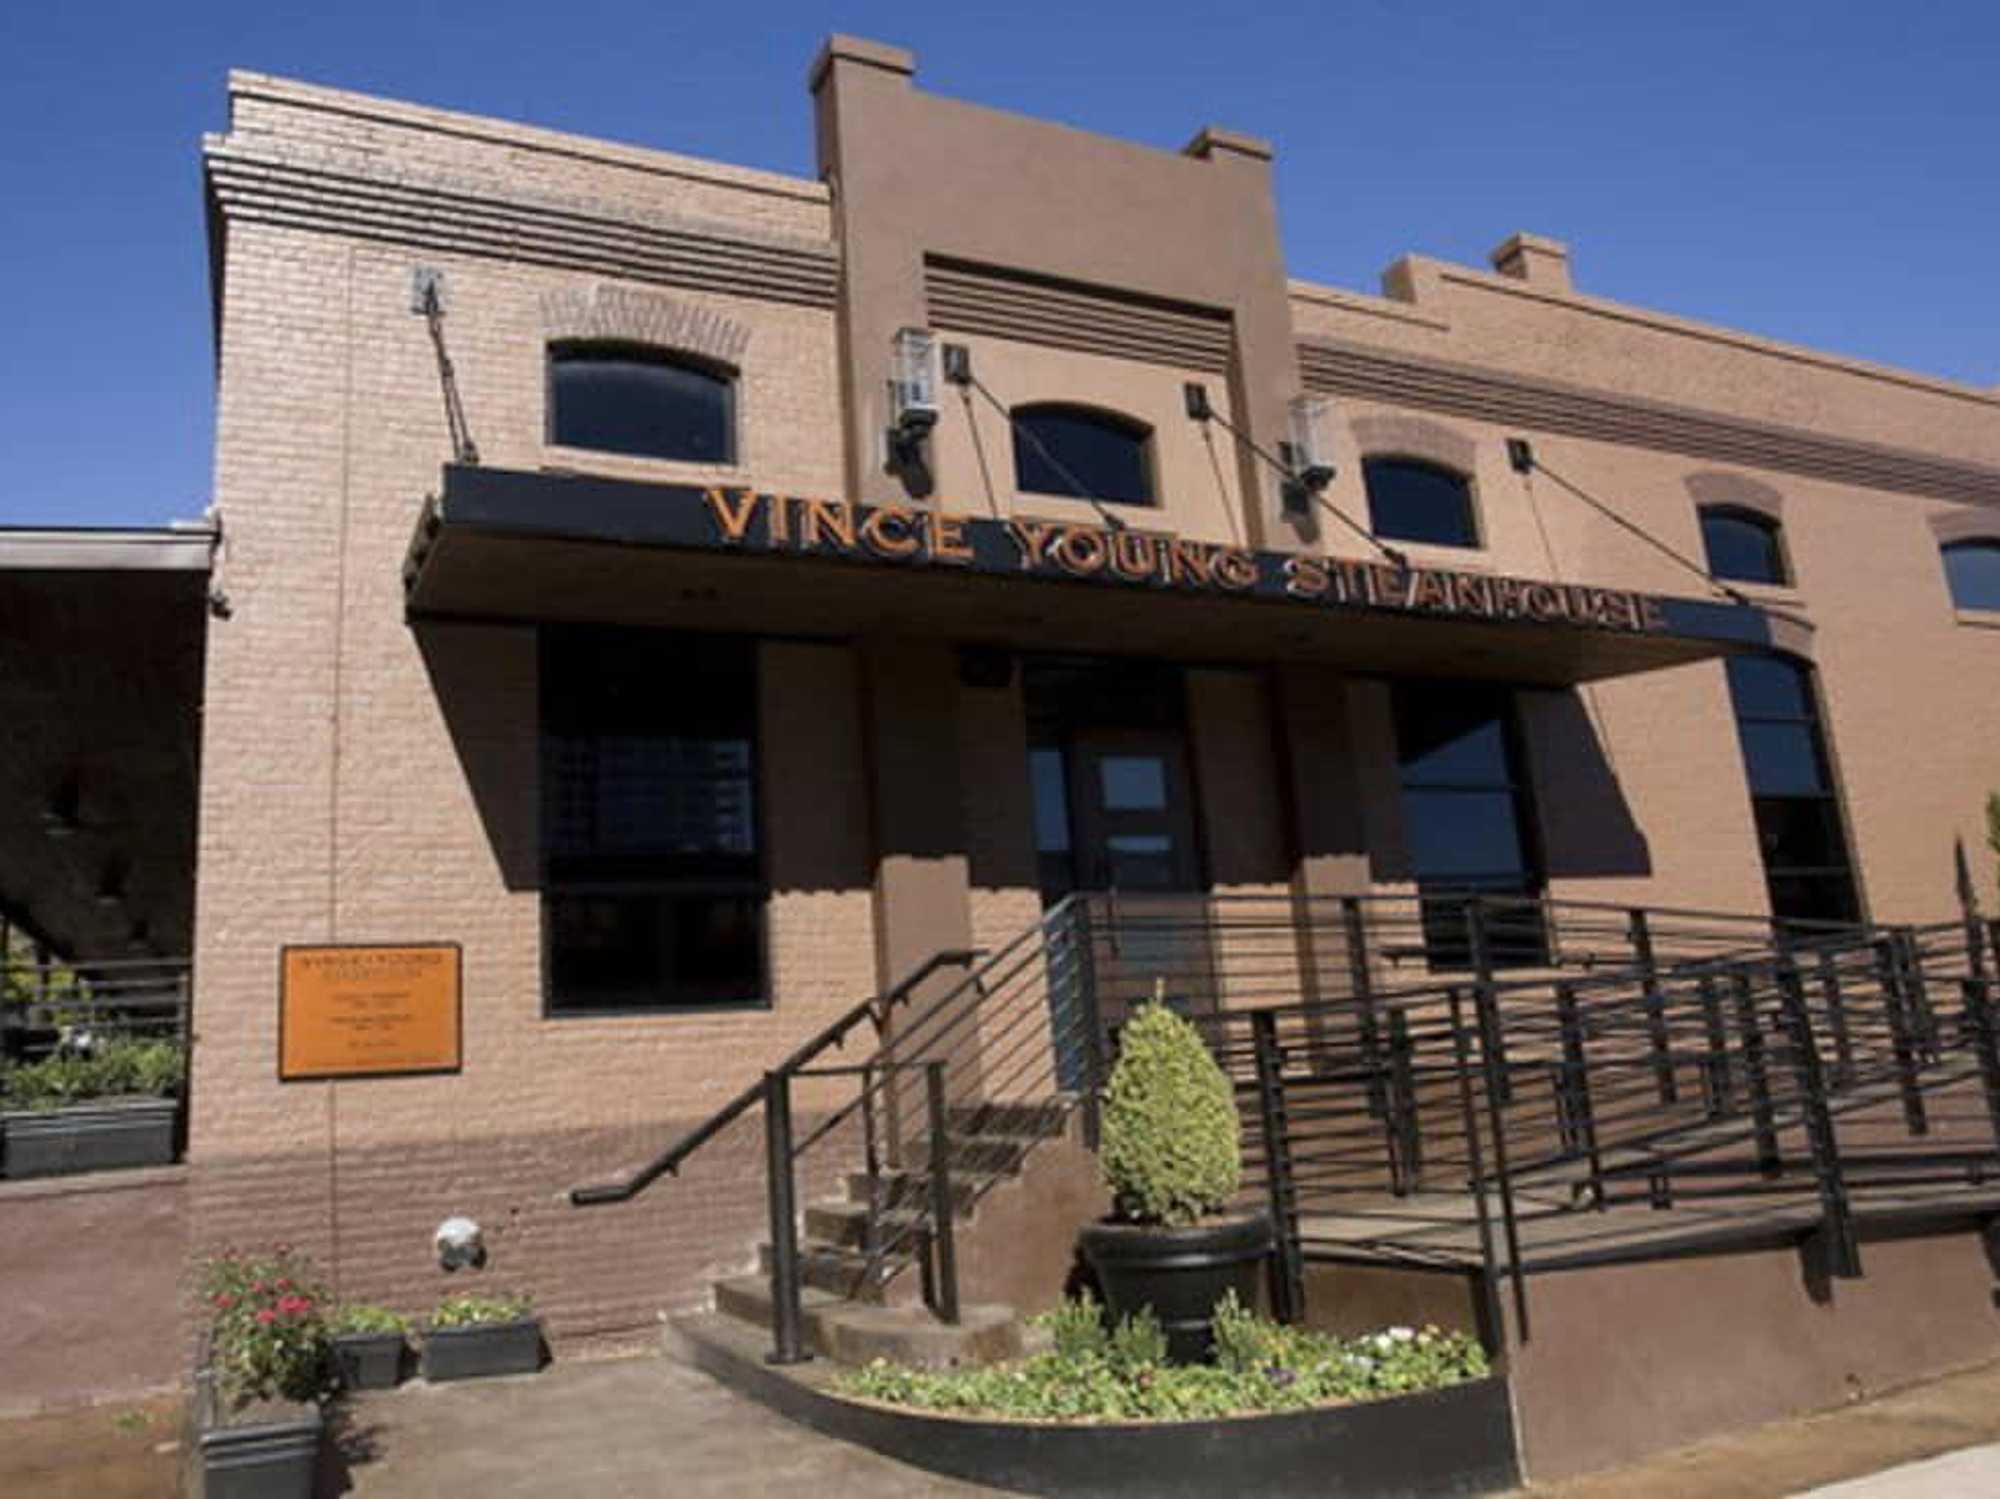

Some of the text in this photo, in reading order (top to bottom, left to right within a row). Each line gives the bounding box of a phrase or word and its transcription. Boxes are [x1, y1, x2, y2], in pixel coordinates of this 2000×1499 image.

[705, 486, 1666, 630] VINCE YOUNG STEAKHOUSE
